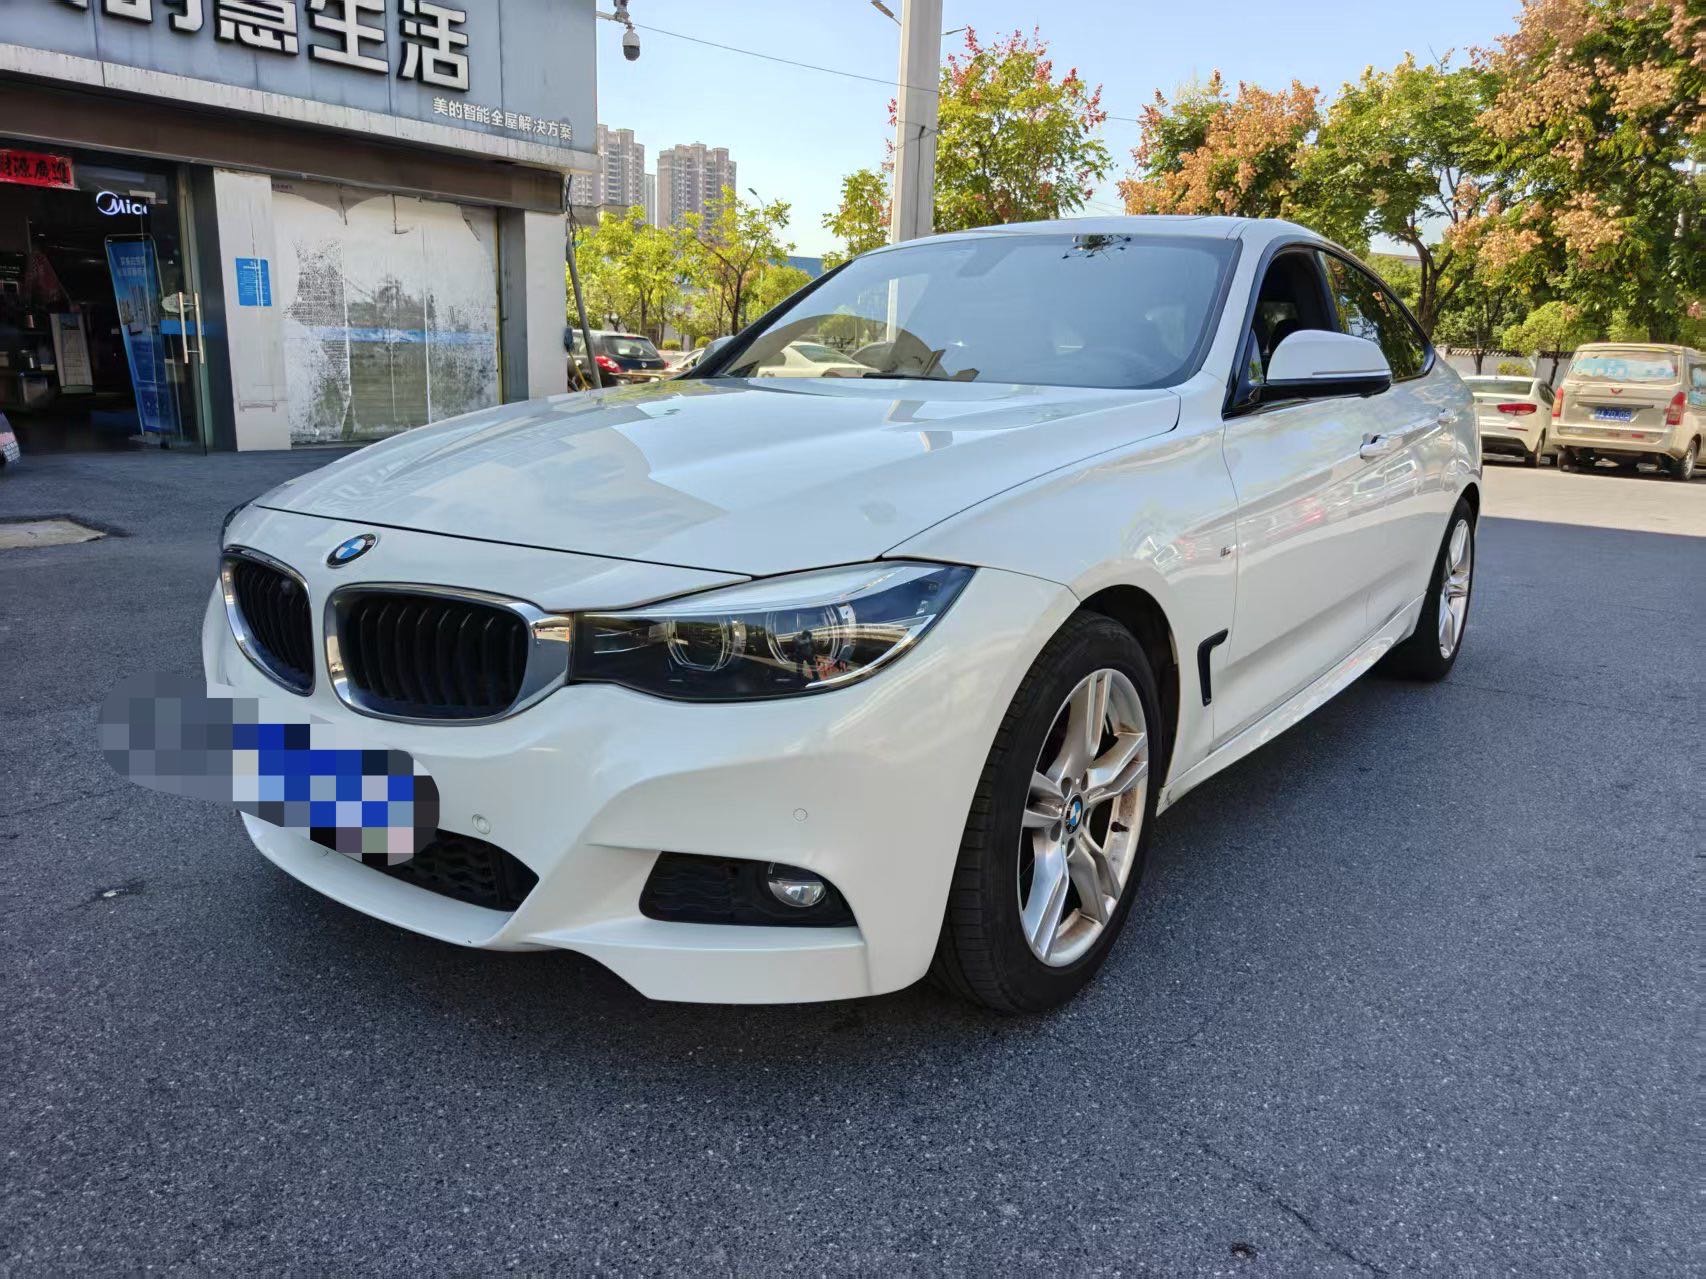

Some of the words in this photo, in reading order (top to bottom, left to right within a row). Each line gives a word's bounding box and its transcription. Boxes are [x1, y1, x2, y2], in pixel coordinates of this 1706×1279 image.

[433, 97, 572, 140] 美的智能全屋解决方案
